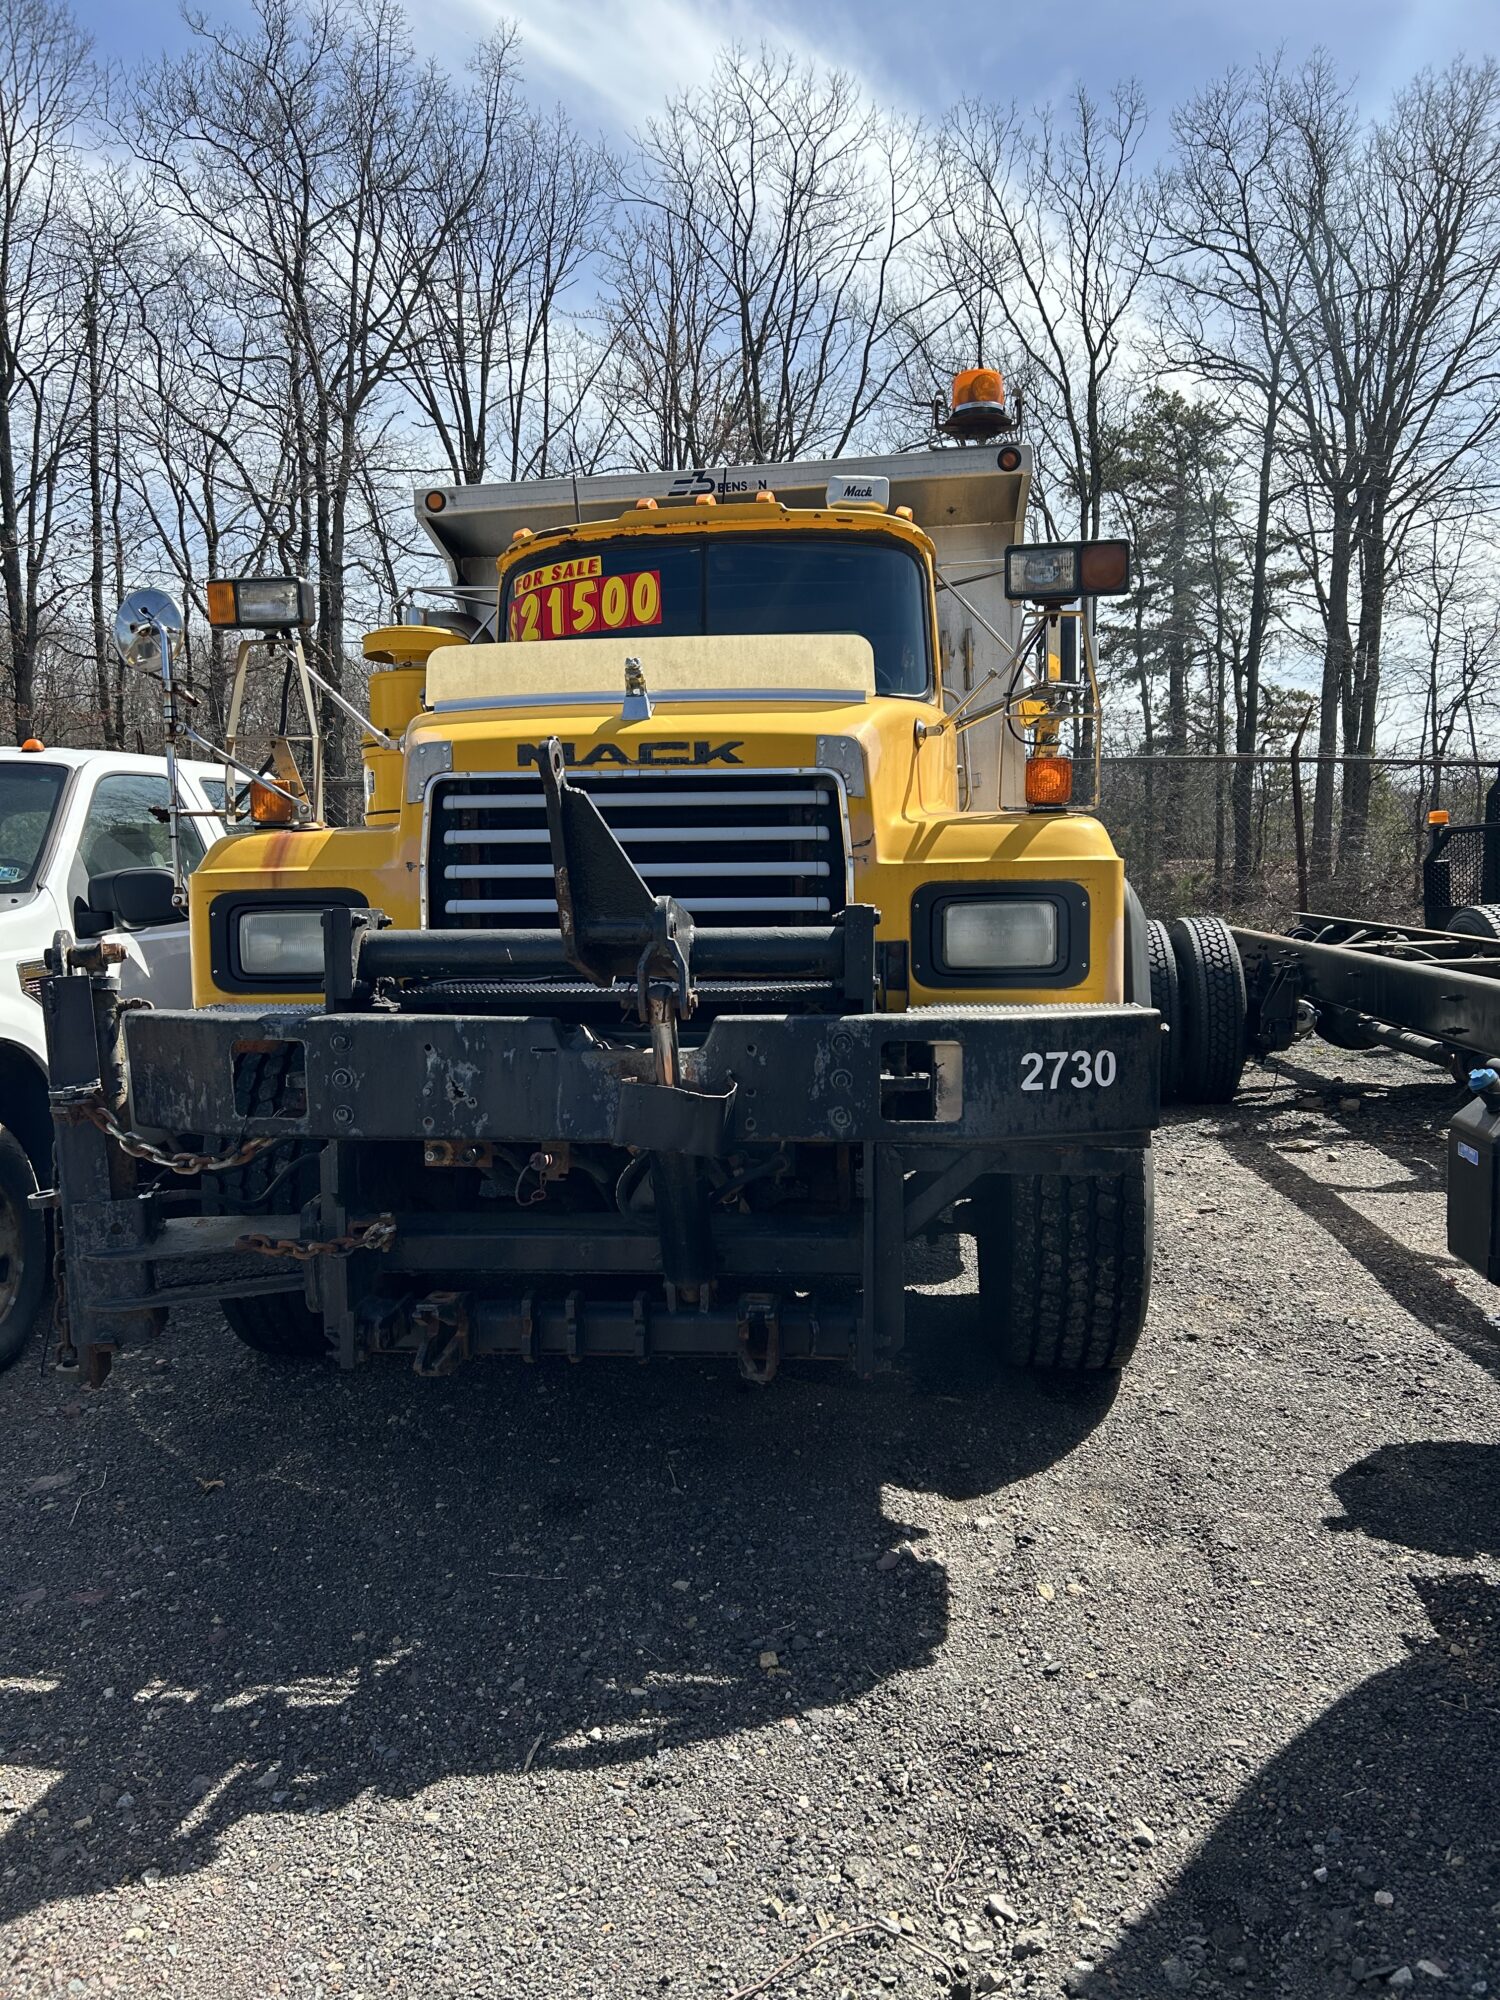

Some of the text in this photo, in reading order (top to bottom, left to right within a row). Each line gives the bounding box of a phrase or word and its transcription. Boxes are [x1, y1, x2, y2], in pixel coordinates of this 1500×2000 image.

[718, 480, 767, 493] BENSN
[843, 485, 873, 497] Mack
[515, 558, 600, 595] FOR SALE
[510, 572, 660, 641] $21500
[1020, 1050, 1116, 1090] 2730
